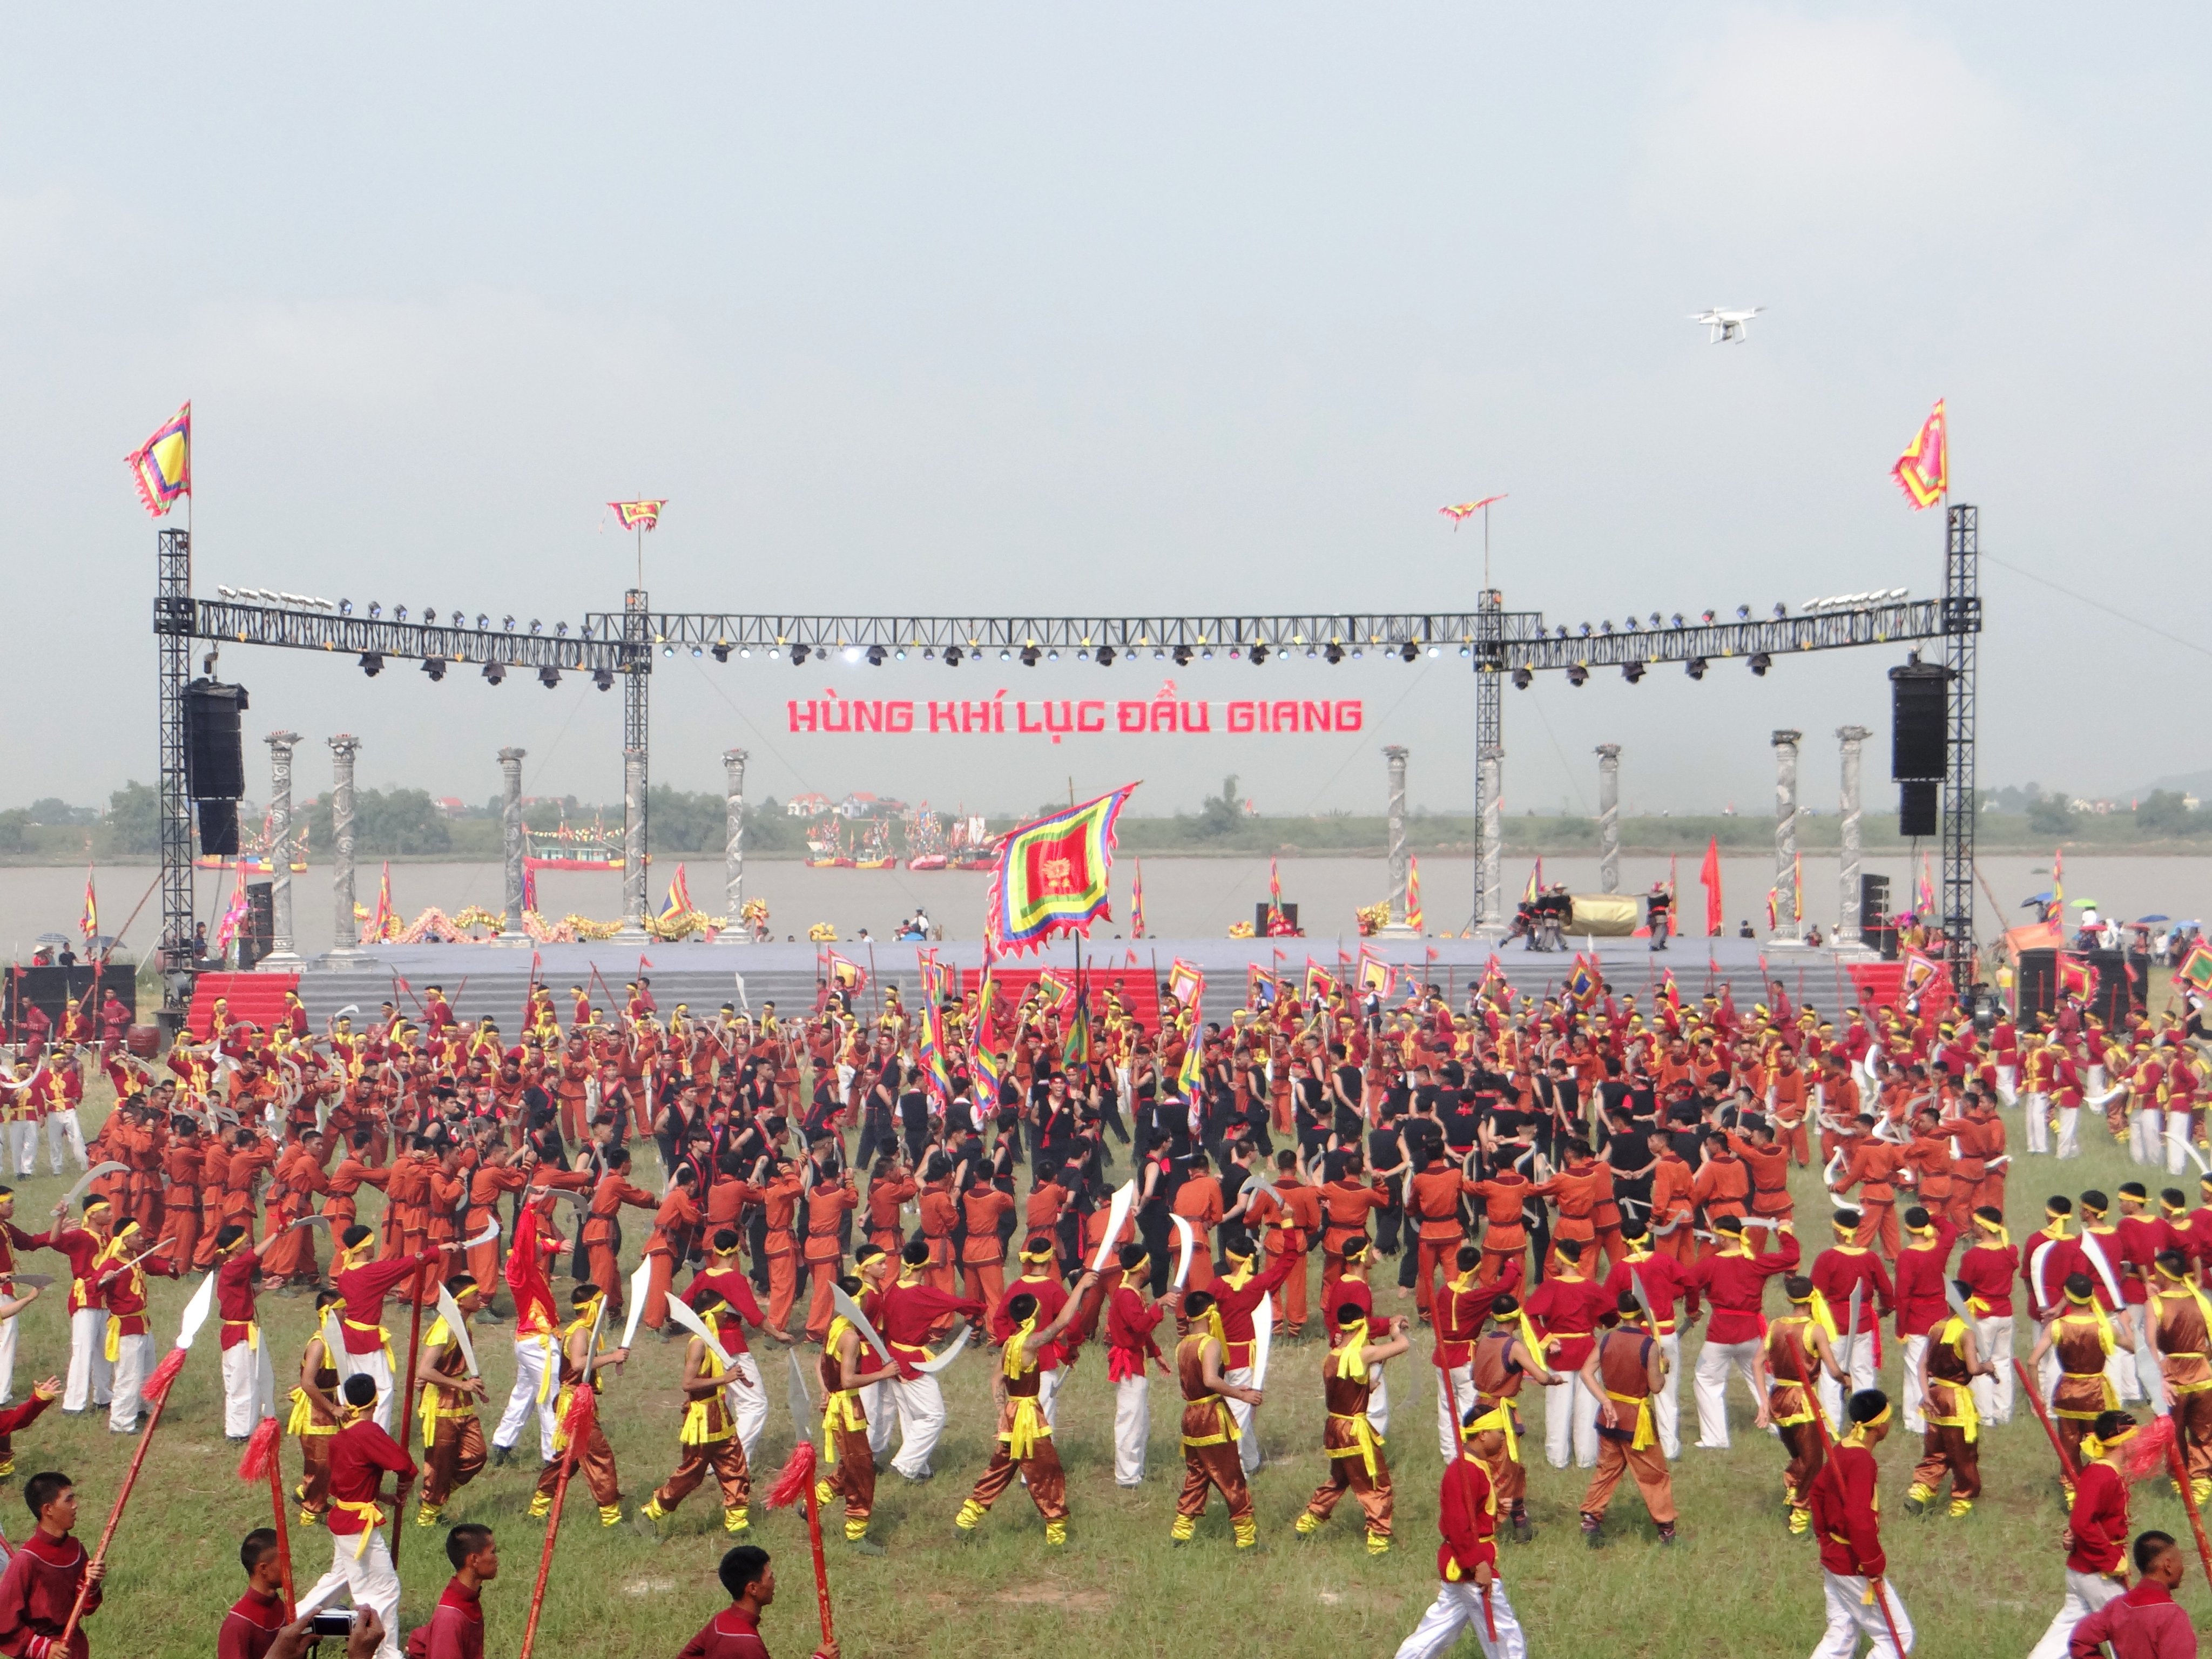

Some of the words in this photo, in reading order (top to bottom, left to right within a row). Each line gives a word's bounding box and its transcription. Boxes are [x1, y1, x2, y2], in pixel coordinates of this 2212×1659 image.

[786, 687, 914, 733] HÙNG
[927, 688, 1008, 734] KHÍ
[1015, 700, 1106, 744] LỤC
[1116, 679, 1210, 733] ĐẦU
[1226, 699, 1363, 734] GIANG
